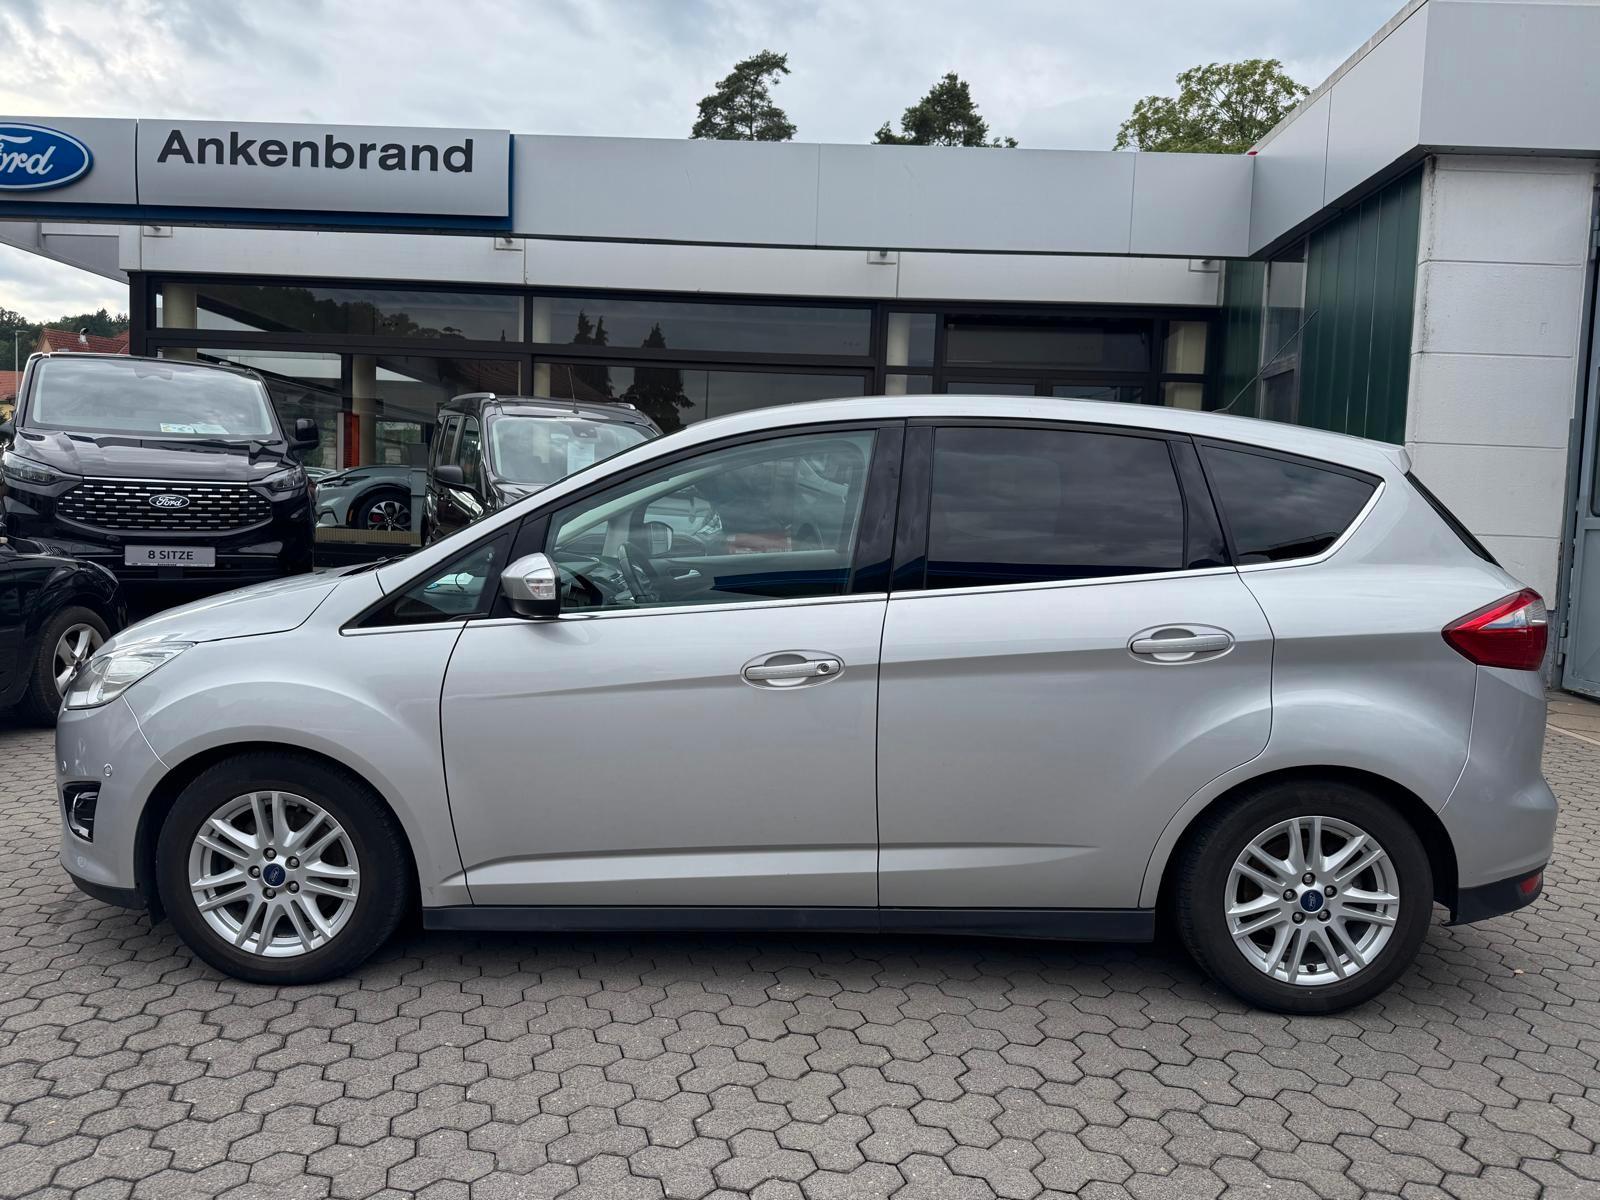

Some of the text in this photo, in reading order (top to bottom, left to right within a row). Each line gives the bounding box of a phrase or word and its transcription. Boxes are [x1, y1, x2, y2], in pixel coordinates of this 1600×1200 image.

[157, 129, 474, 173] Ankenbrand
[155, 496, 183, 507] Ford
[147, 550, 194, 561] 8 SITZE
